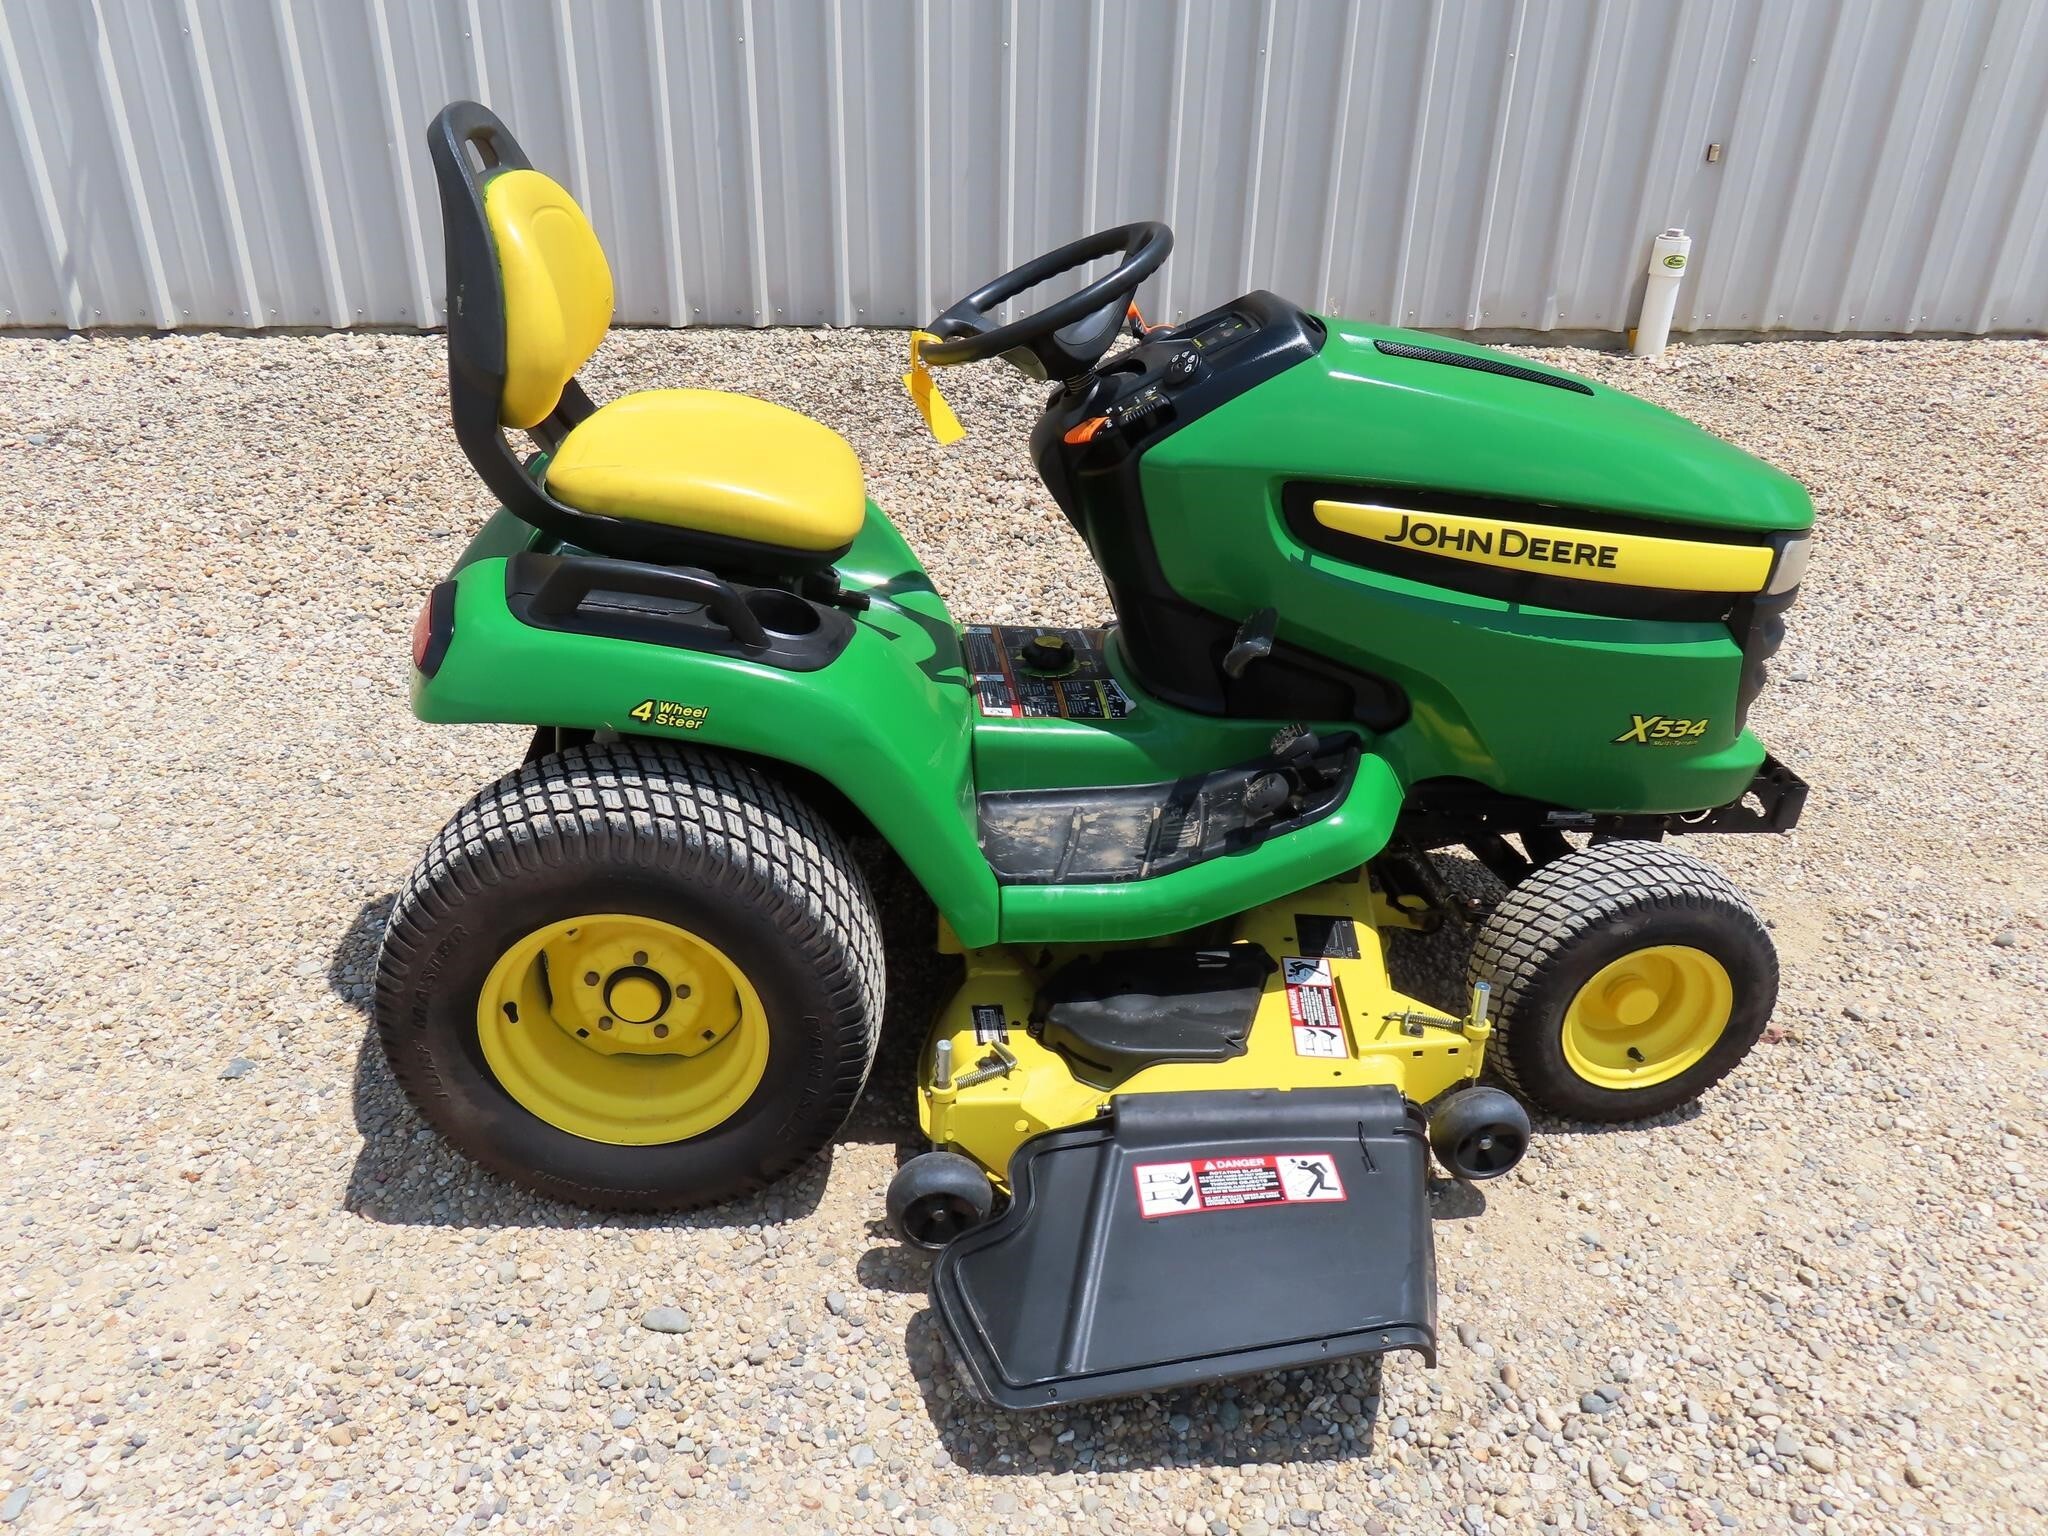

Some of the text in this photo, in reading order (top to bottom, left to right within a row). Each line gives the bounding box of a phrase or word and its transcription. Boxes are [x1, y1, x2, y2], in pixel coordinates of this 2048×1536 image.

[1384, 515, 1619, 568] JOHN DEERE
[631, 700, 708, 721] 4 Wheel
[655, 713, 704, 729] Steer
[1615, 715, 1709, 743] X534
[1287, 989, 1299, 1016] DANGER
[1215, 1158, 1265, 1168] DANGER
